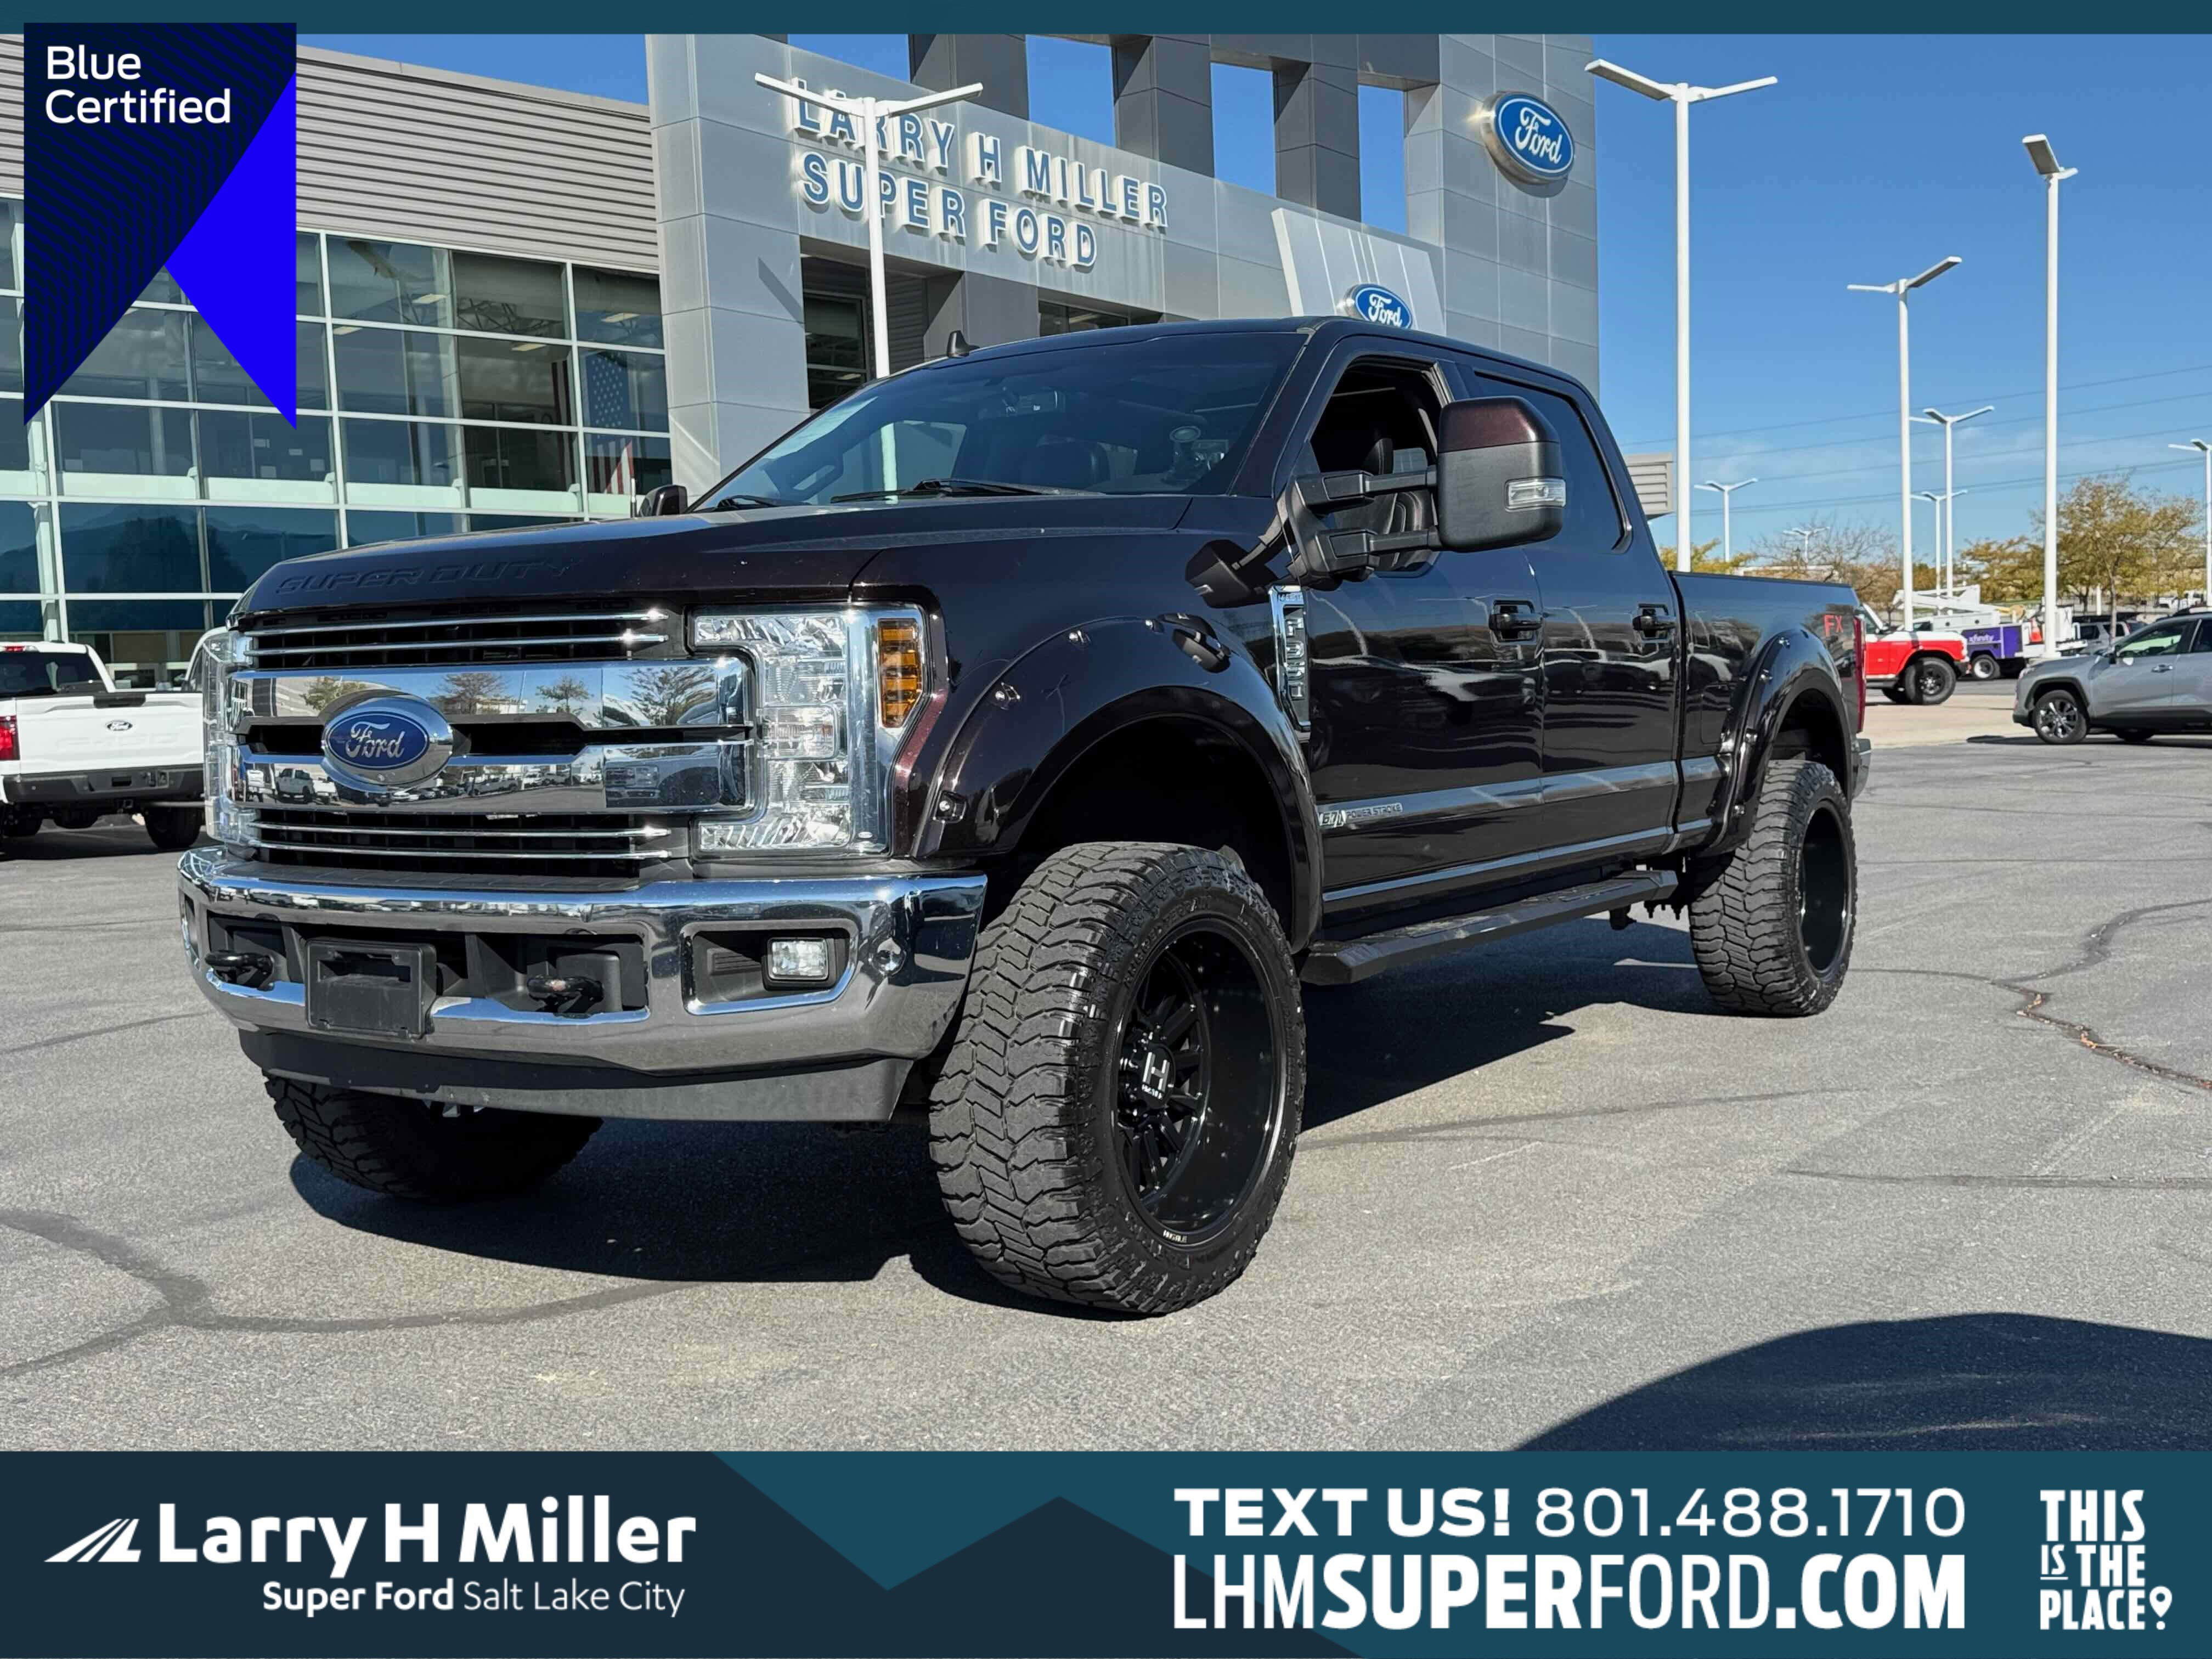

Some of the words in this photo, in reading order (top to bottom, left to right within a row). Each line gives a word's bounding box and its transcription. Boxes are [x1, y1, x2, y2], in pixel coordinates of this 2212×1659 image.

[1515, 106, 1563, 164] Ford
[975, 131, 1001, 183] H
[1020, 145, 1167, 228] MILLER
[798, 151, 967, 237] SUPER
[986, 198, 1097, 267] FORD
[1368, 293, 1403, 328] Ford
[275, 567, 425, 595] SUPER
[428, 557, 584, 584] DUTY
[346, 721, 405, 758] Ford
